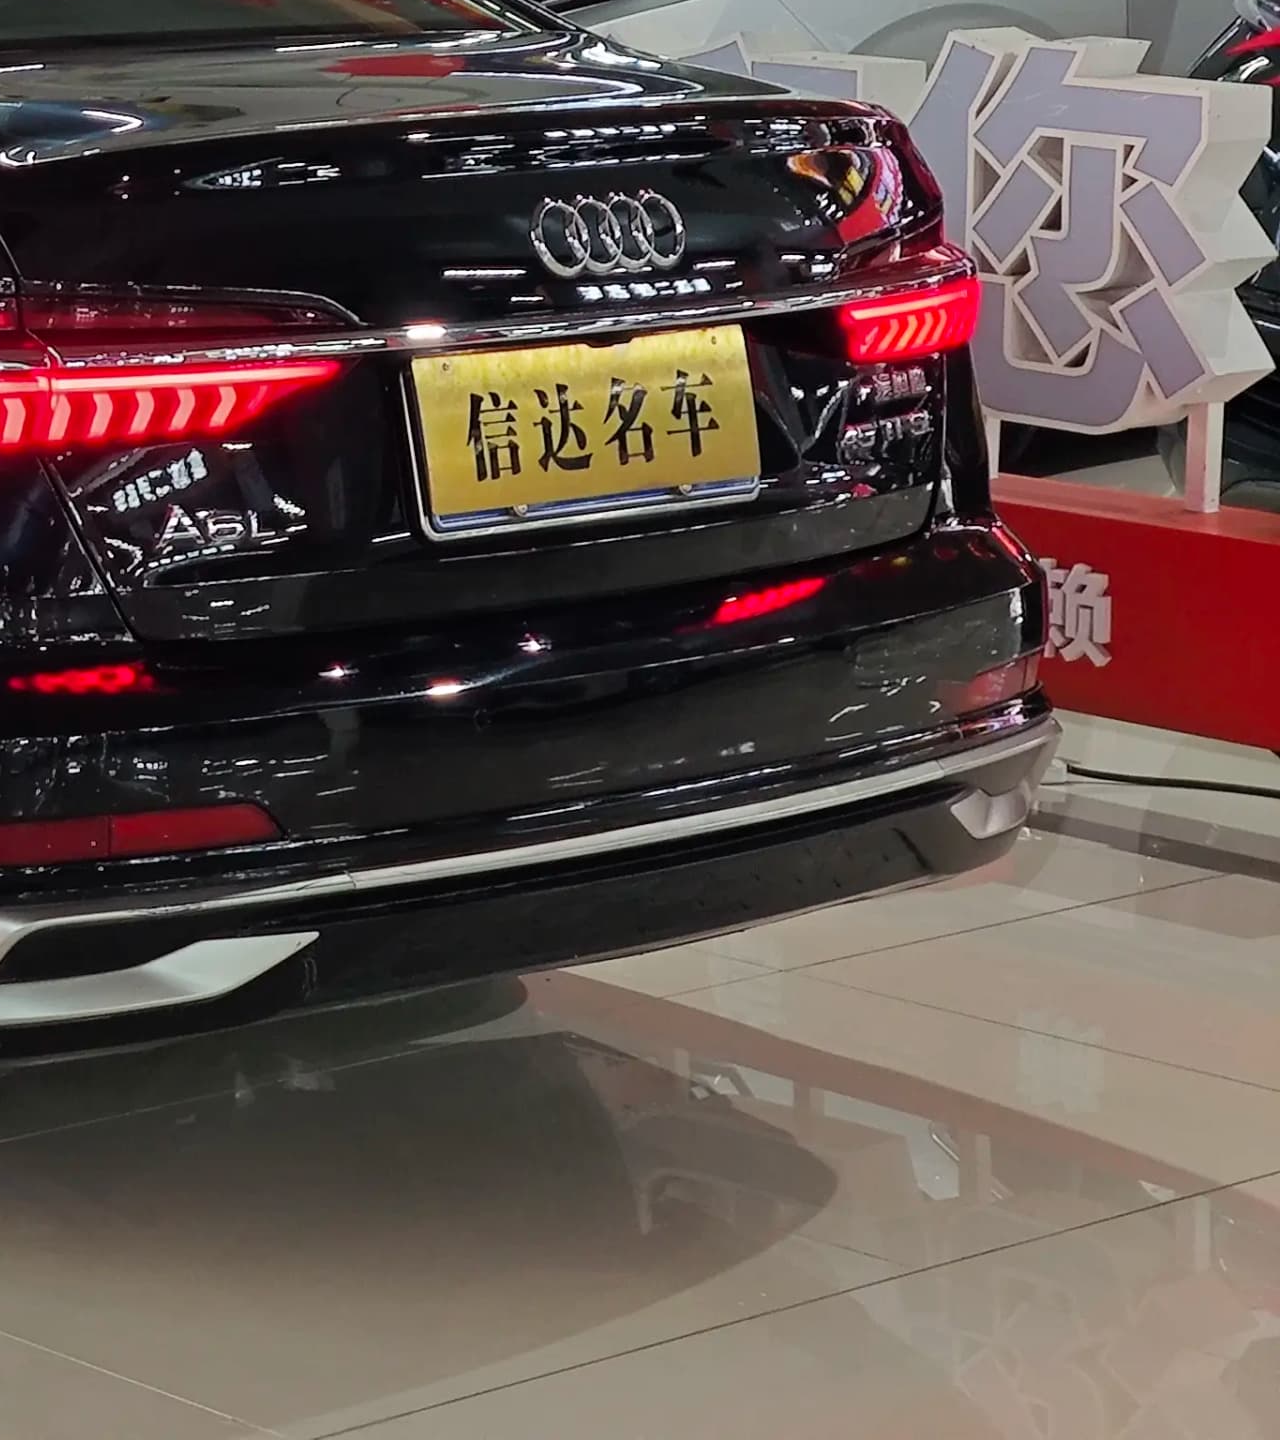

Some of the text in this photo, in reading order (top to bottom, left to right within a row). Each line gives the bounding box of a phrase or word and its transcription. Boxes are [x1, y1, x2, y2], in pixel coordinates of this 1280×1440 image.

[467, 369, 719, 482] 信达名车
[156, 505, 276, 549] A6L
